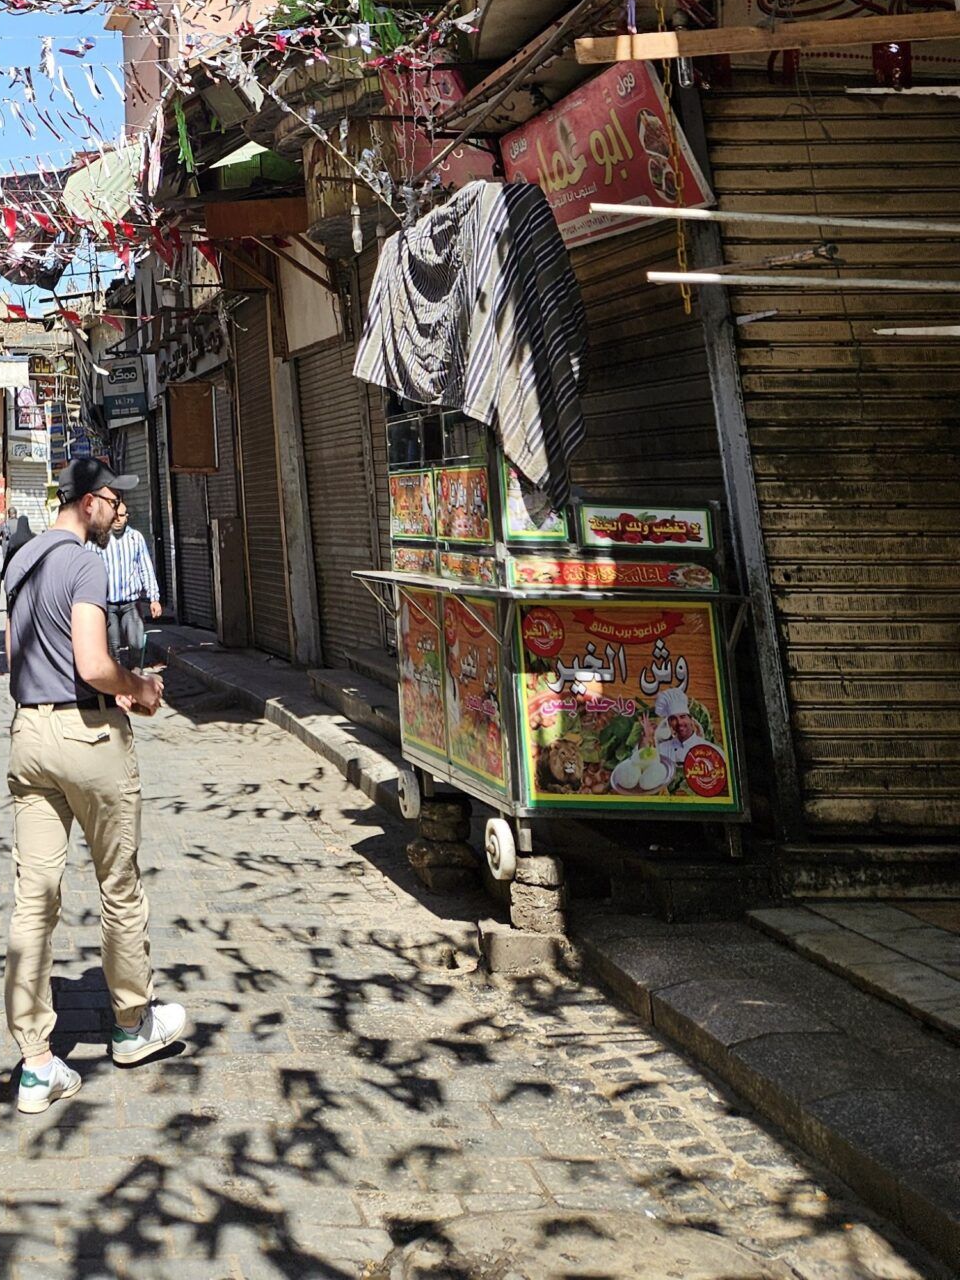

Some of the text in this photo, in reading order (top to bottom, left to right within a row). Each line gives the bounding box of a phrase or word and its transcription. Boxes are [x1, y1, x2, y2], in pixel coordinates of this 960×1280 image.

[616, 71, 636, 97] فول
[108, 369, 137, 383] ممكن
[589, 518, 701, 536] لا تغضب ولك الجنة
[589, 620, 615, 635] الفلق
[615, 628, 632, 639] برب
[653, 621, 667, 635] قل
[546, 638, 690, 695] وش الخير
[541, 695, 636, 717] واحد بس
